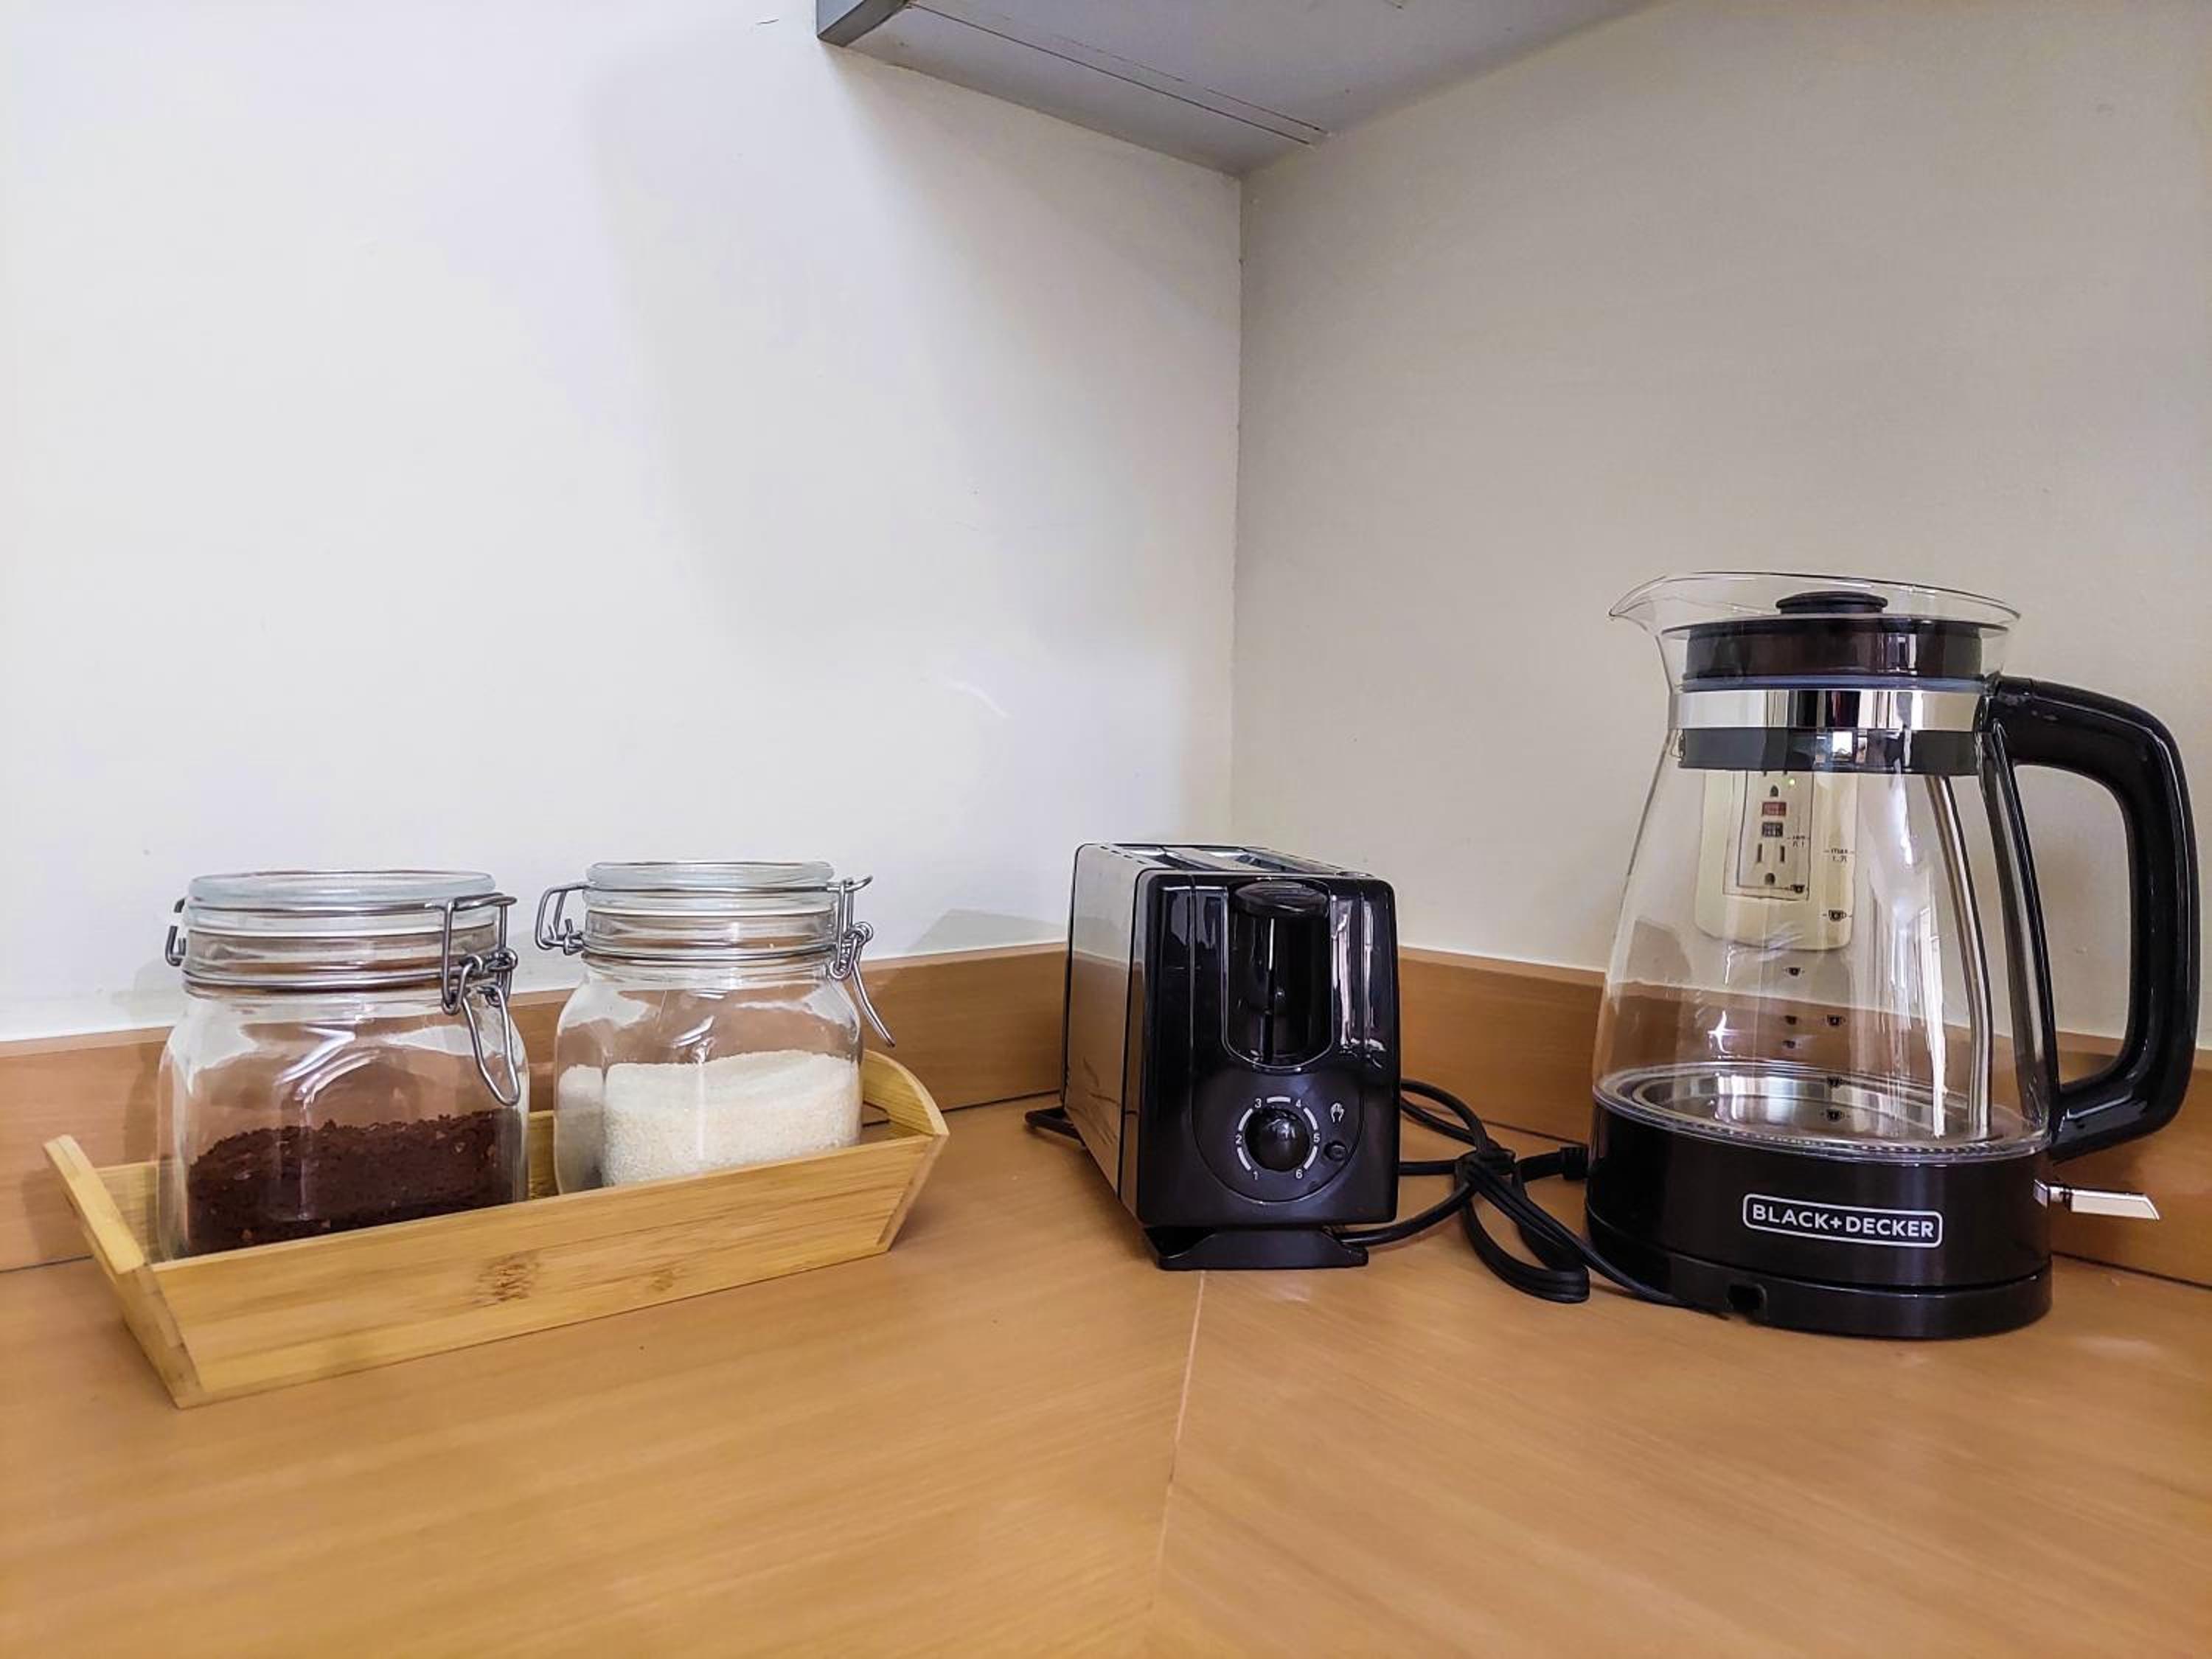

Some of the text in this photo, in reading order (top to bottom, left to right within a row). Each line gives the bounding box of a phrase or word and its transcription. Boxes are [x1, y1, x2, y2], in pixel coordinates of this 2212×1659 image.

[1255, 1098, 1262, 1108] 3
[1295, 1099, 1301, 1107] 4
[1235, 1135, 1242, 1144] 2
[1313, 1133, 1320, 1142] 5
[1253, 1171, 1258, 1180] 1
[1295, 1169, 1302, 1178] 6
[1752, 1203, 1934, 1238] BLACK+DECKER
